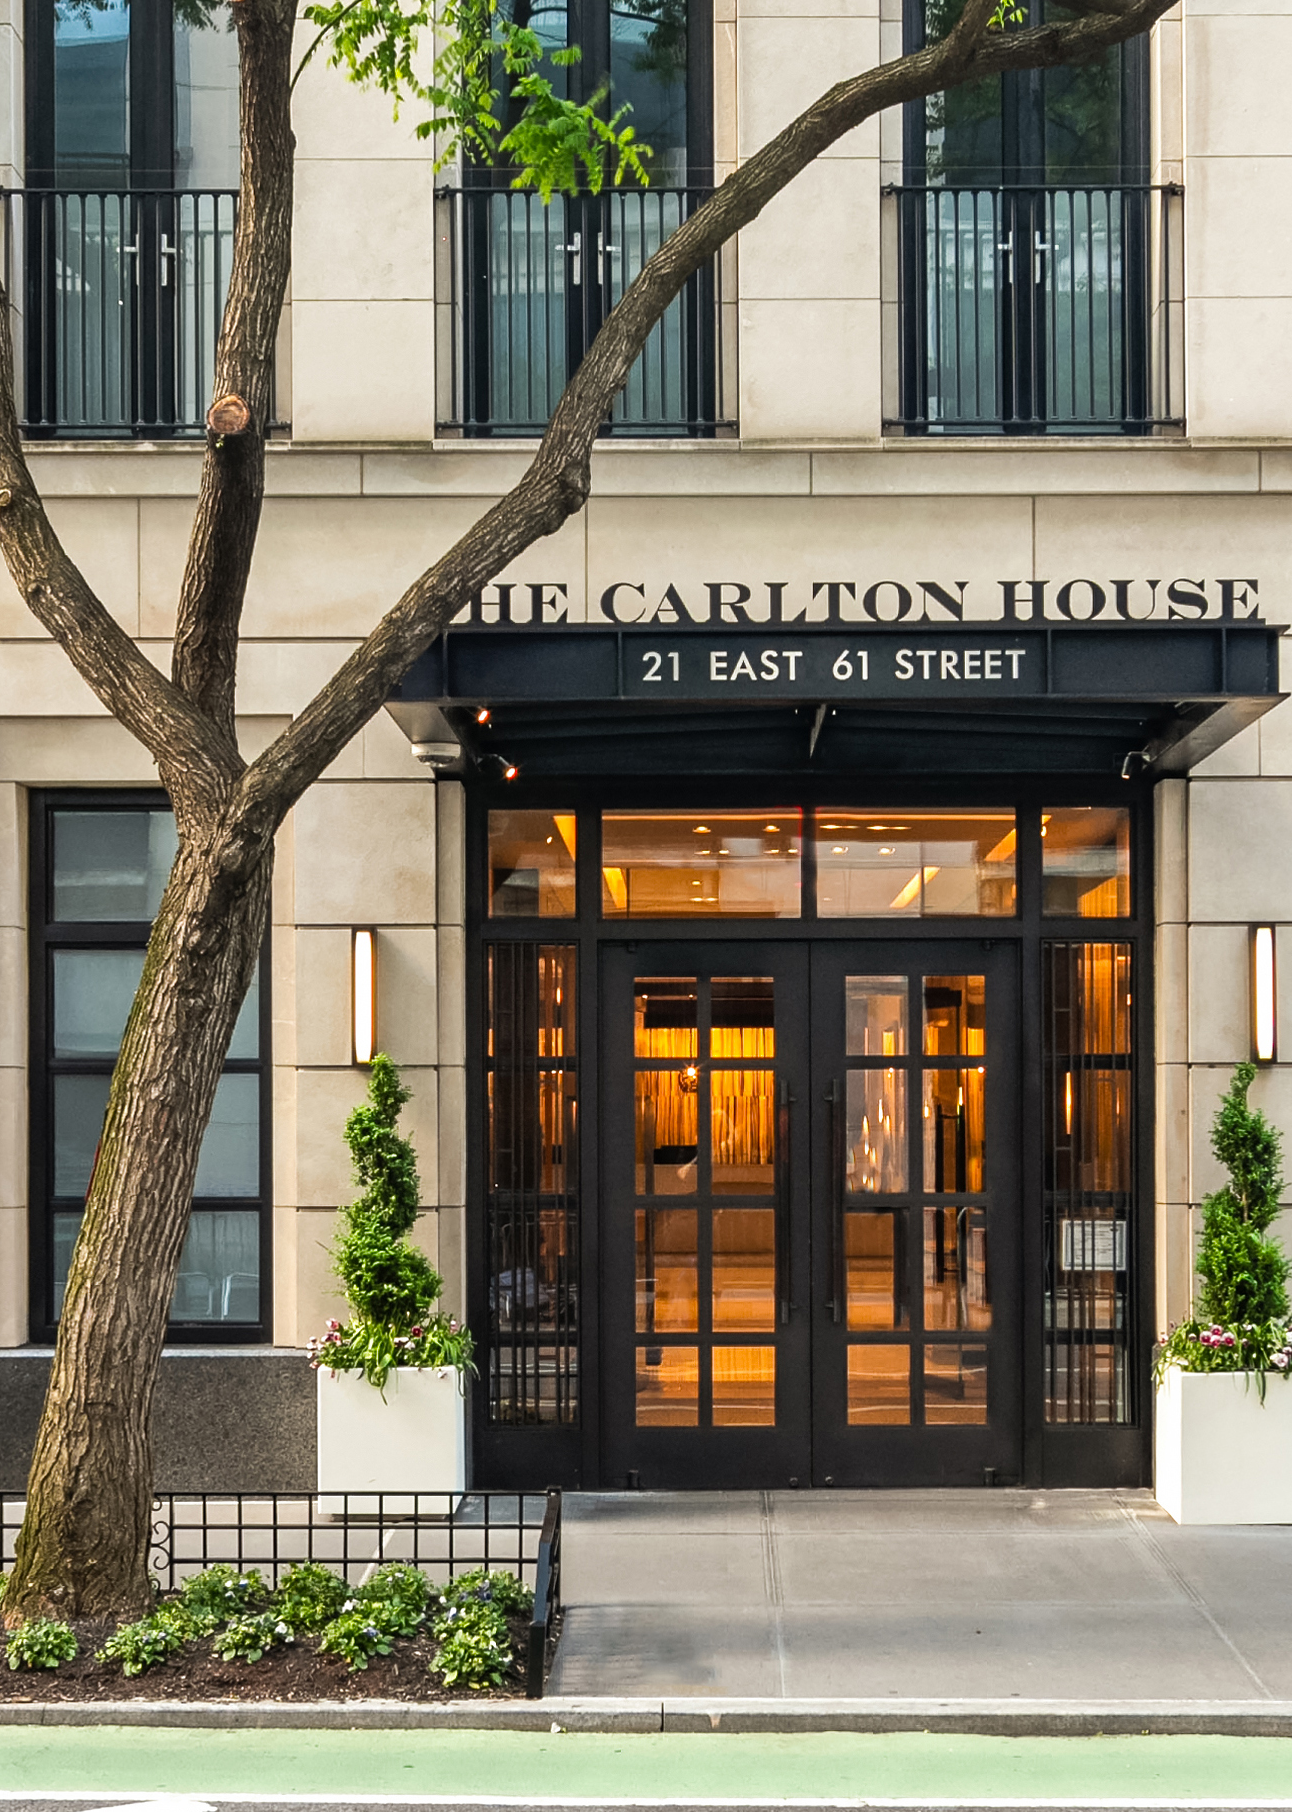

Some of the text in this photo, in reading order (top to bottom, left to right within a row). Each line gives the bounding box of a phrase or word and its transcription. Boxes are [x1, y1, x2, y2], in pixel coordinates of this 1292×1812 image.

[452, 579, 1260, 623] HE CARLTON HOUSE
[642, 649, 1026, 682] 21 EAST 61 STREET
